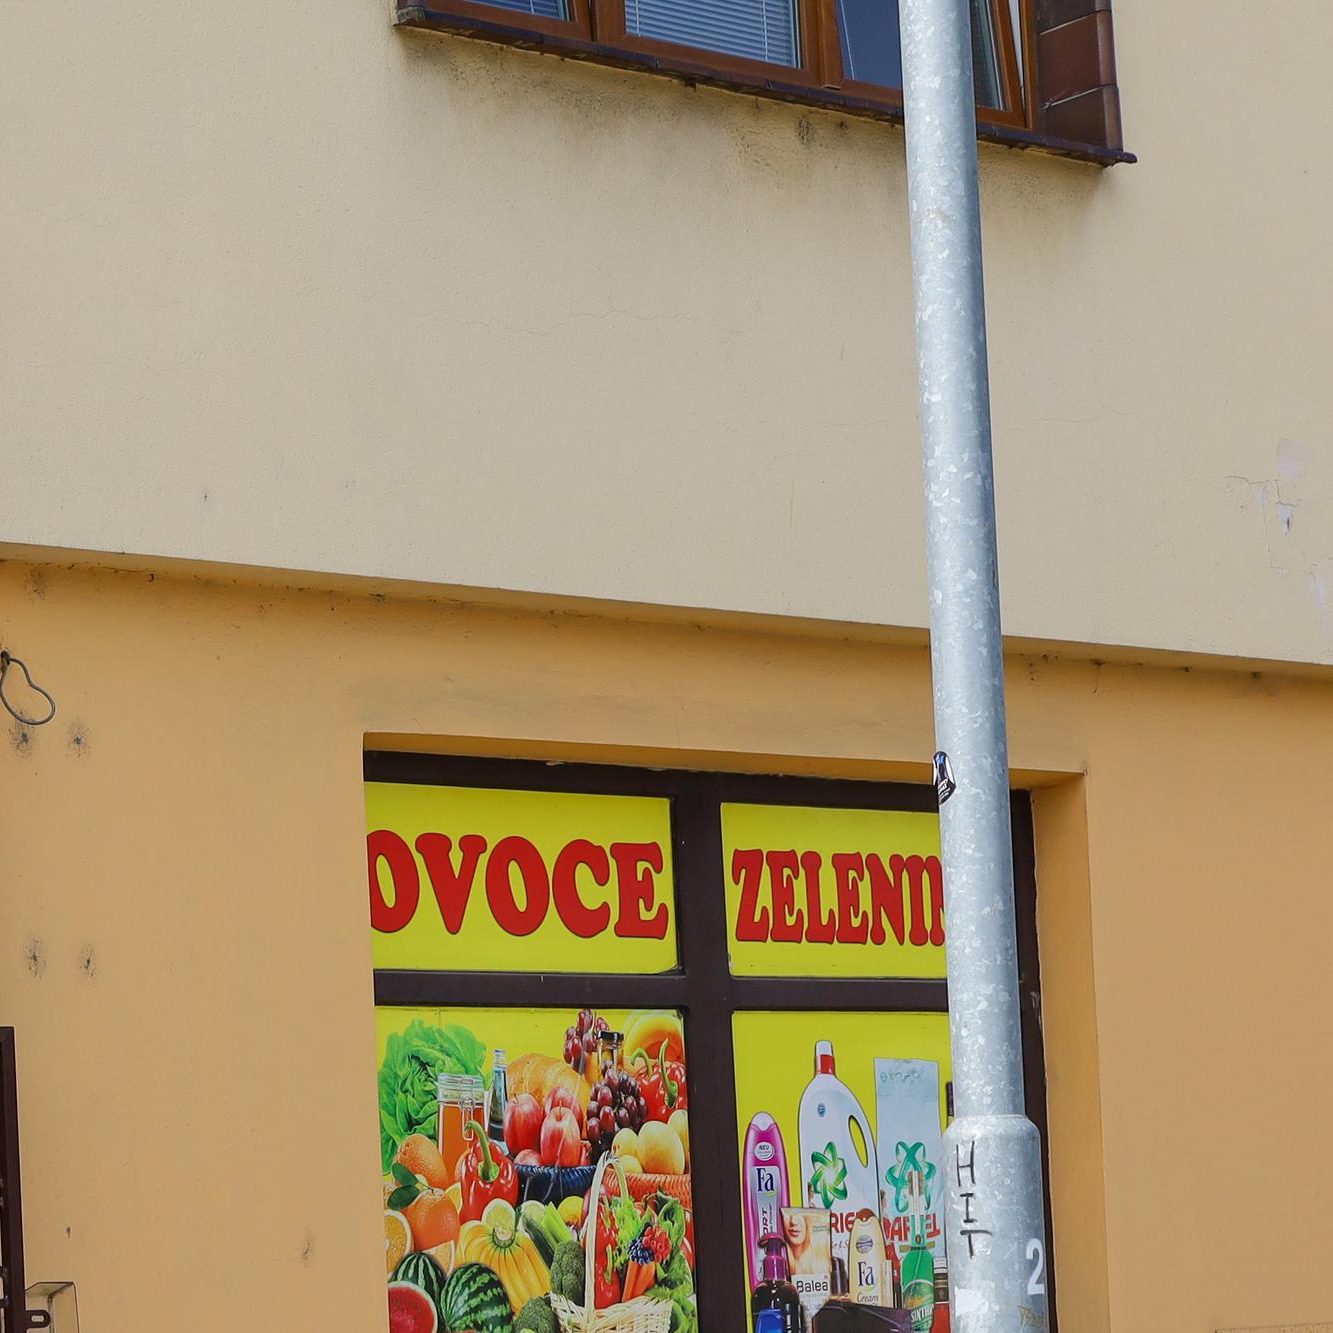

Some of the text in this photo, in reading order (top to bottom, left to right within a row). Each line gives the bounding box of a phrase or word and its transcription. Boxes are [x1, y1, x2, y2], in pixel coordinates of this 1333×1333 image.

[366, 829, 669, 939] OVOCE
[732, 848, 948, 947] ZELENI
[756, 1168, 774, 1192] Fa
[796, 1280, 829, 1292] Balea
[858, 1261, 875, 1287] Fa
[1026, 1238, 1046, 1296] 2
